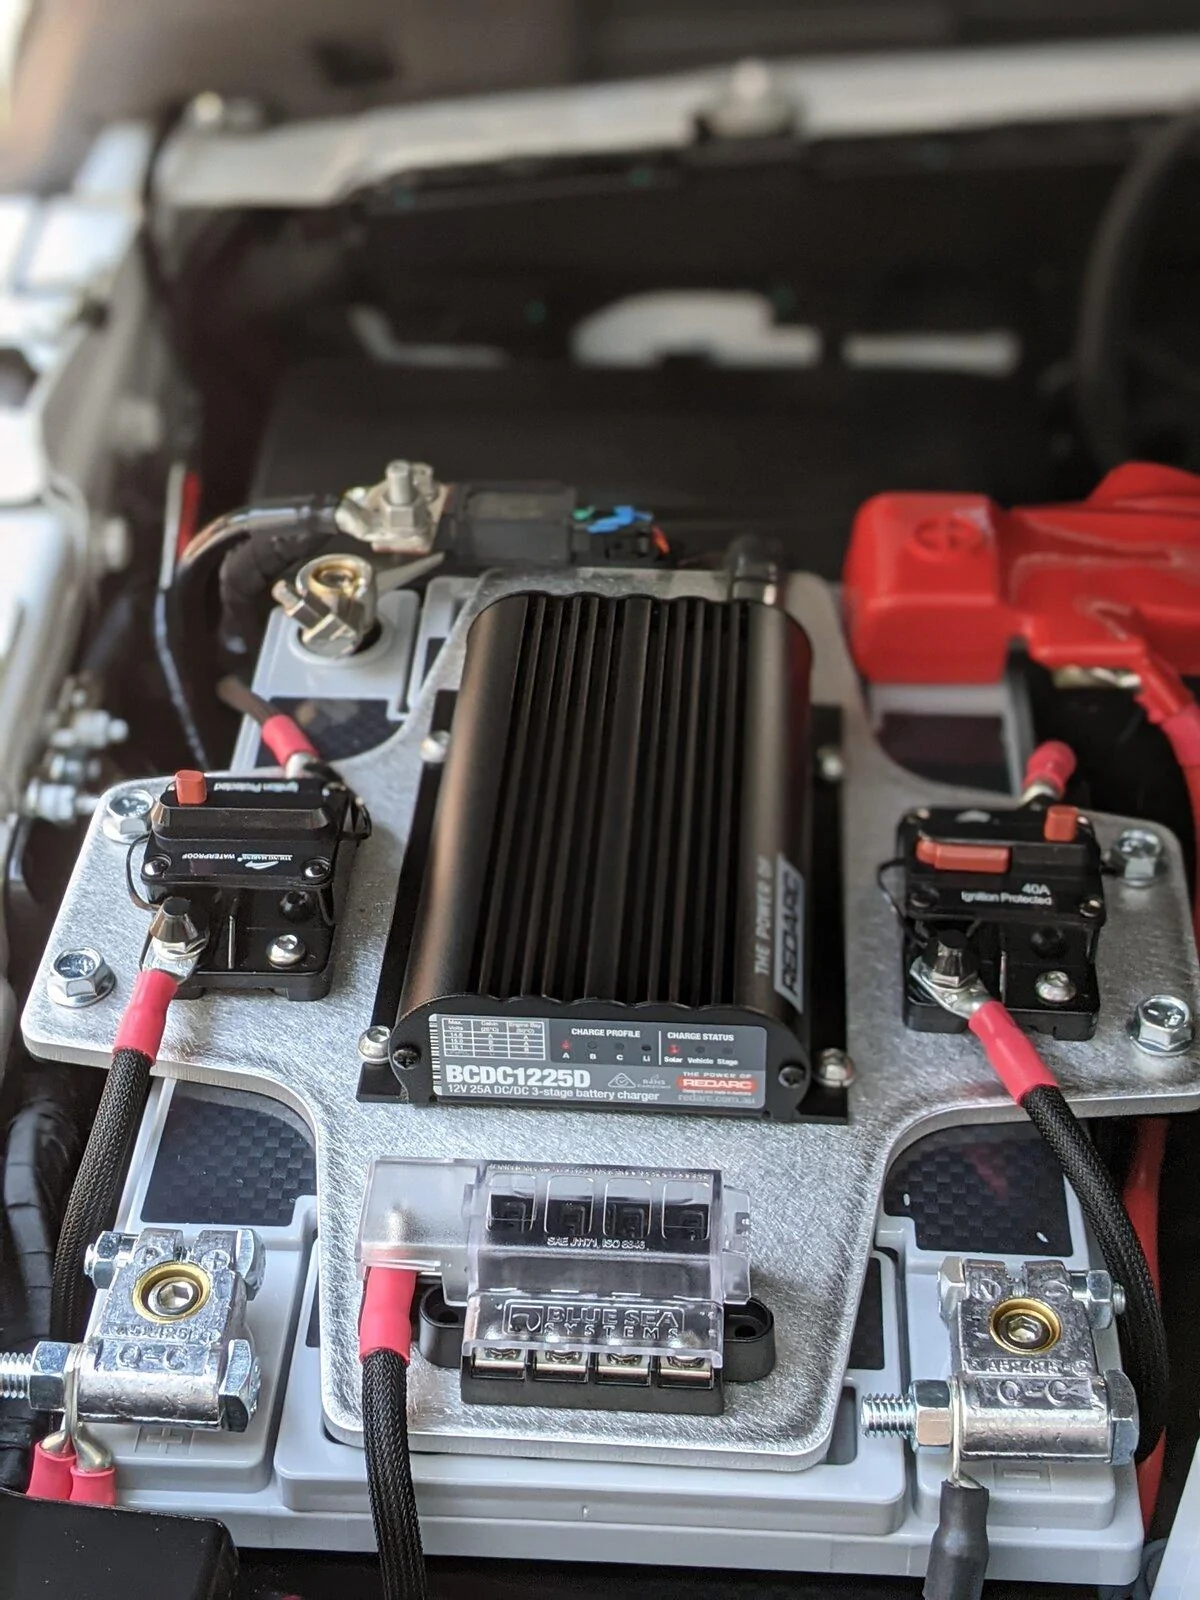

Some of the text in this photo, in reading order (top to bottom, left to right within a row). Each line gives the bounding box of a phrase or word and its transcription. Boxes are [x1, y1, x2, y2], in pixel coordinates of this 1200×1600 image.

[182, 852, 236, 860] WATERPROOF
[1022, 883, 1051, 895] 40A
[961, 891, 1053, 906] Ignition Protected
[571, 1028, 641, 1038] CHARGE PROFILE
[667, 1031, 735, 1042] CHARGE STATUS
[687, 1057, 714, 1065] Vehicle
[717, 1058, 739, 1066] Stage
[445, 1064, 591, 1088] BCDC1225D
[703, 1071, 737, 1079] POWER
[683, 1078, 752, 1090] REDARC
[448, 1084, 660, 1101] 12V 25A DC/DC 3-stage battery charger
[678, 1093, 755, 1105] redarc.com.au
[547, 1236, 569, 1246] SAE
[602, 1238, 620, 1248] ISO
[547, 1306, 679, 1328] BLUE SEA
[543, 1322, 679, 1339] SYSTEMS
